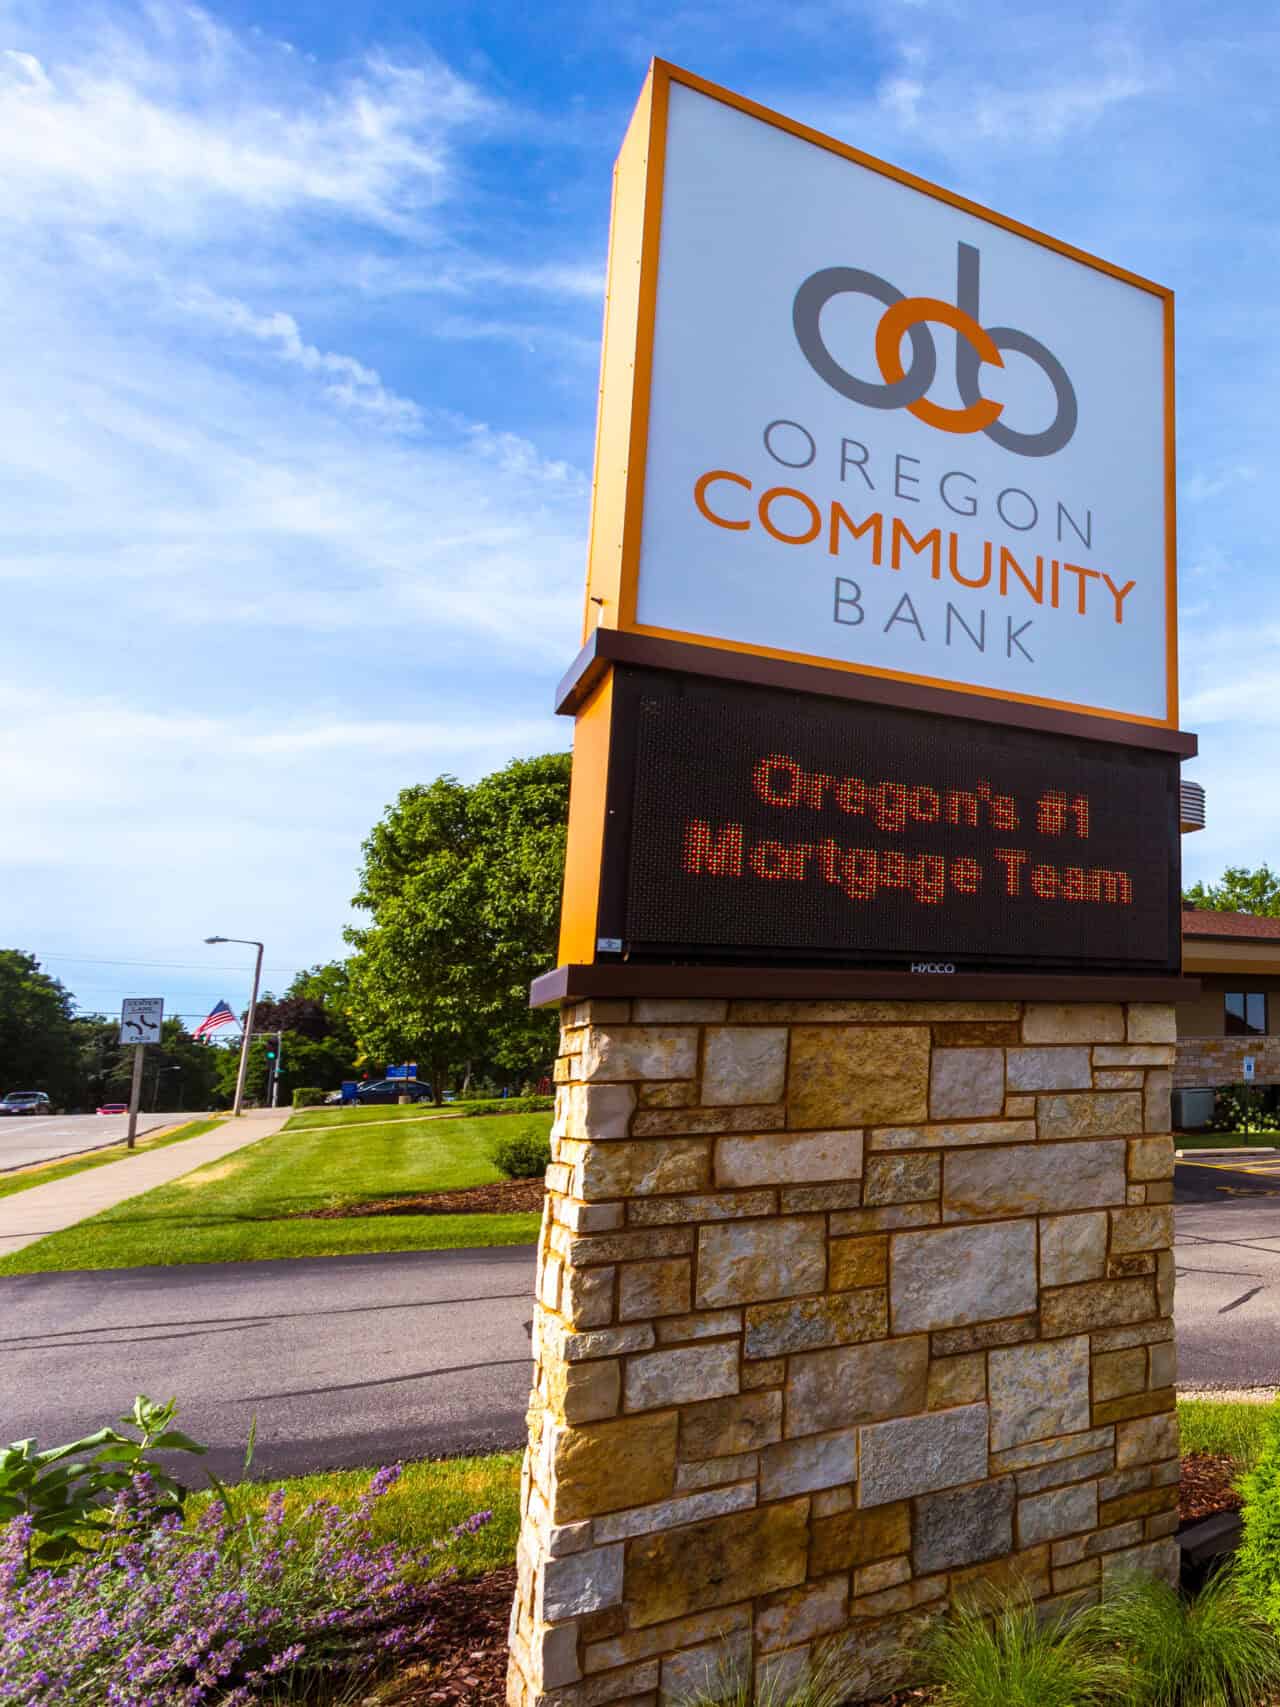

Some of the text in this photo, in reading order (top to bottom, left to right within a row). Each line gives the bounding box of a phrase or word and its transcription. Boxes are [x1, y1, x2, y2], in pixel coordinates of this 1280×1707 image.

[763, 419, 1092, 550] OREGON
[693, 469, 1137, 624] COMMUNITY
[833, 576, 1034, 663] BANK
[752, 753, 1090, 840] Oregon's #1
[682, 816, 1133, 904] Mortgage Team
